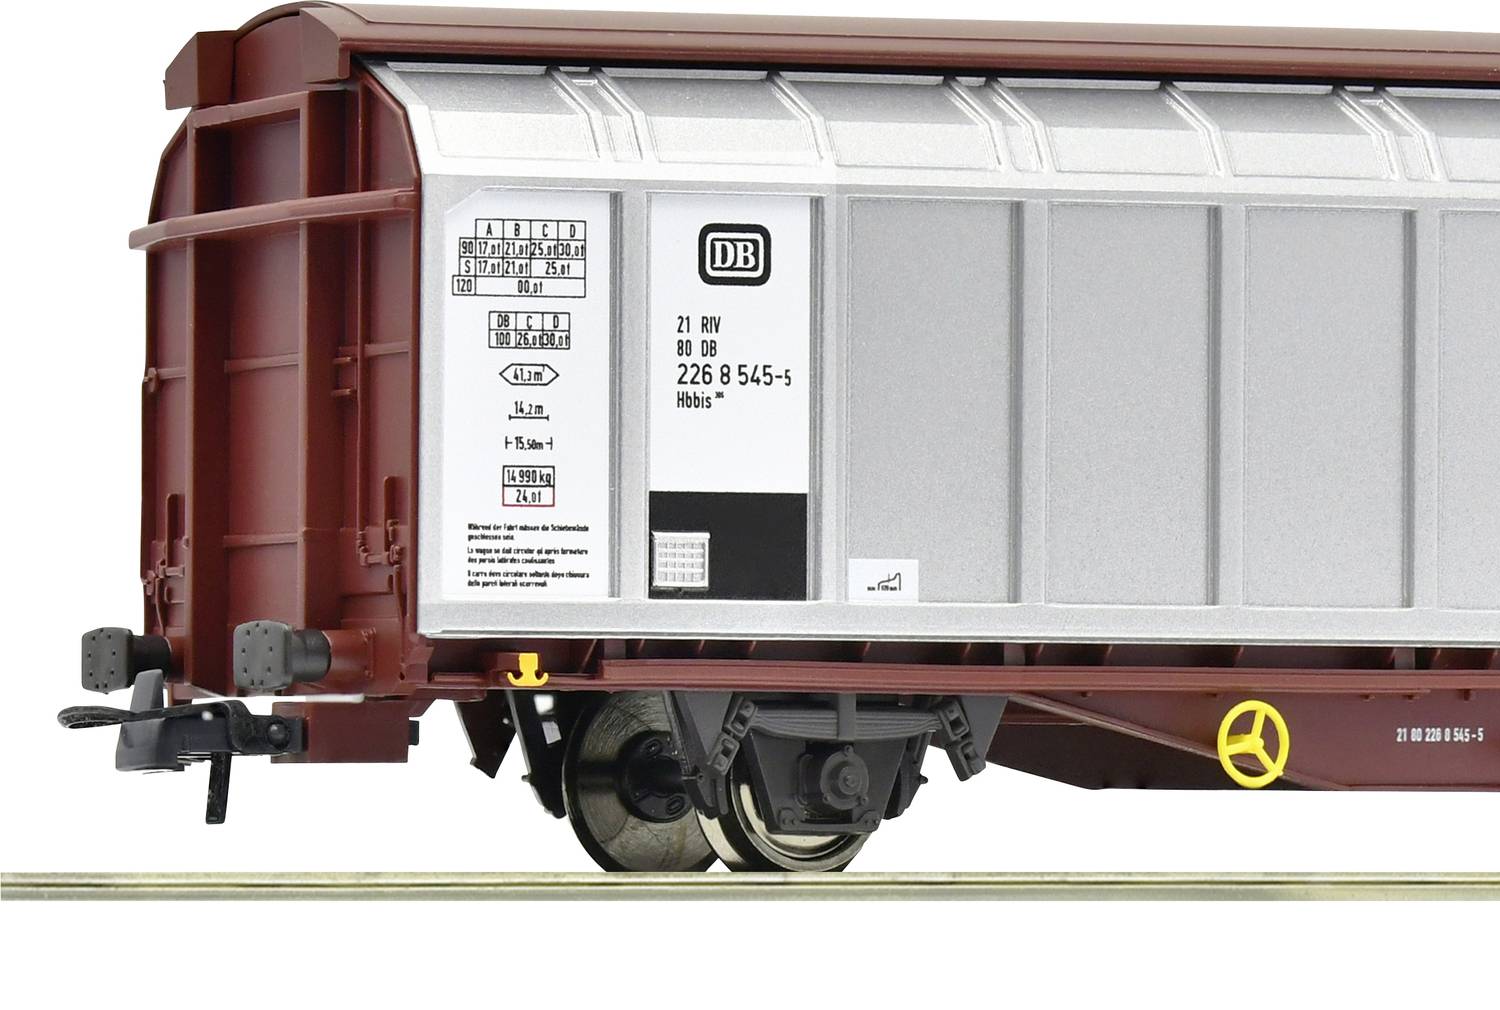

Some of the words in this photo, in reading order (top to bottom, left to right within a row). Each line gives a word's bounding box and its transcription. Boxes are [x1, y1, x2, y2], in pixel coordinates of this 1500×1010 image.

[486, 222, 492, 236] A
[514, 223, 520, 237] B
[542, 224, 548, 237] C
[570, 224, 576, 238] D
[462, 241, 473, 254] 90
[713, 241, 756, 269] DB
[465, 260, 470, 274] S
[457, 279, 472, 292] 120
[498, 314, 509, 328] DB
[526, 316, 532, 329] C
[553, 316, 559, 328] D
[677, 316, 689, 333] 21
[702, 316, 720, 333] RIV
[495, 332, 510, 346] 100
[677, 340, 691, 356] 80
[702, 340, 717, 357] DB
[677, 363, 712, 385] 226
[720, 364, 730, 385] 8
[738, 365, 791, 386] 545-5
[677, 391, 712, 408] Hbbis
[519, 470, 537, 483] 990
[1396, 728, 1407, 742] 21
